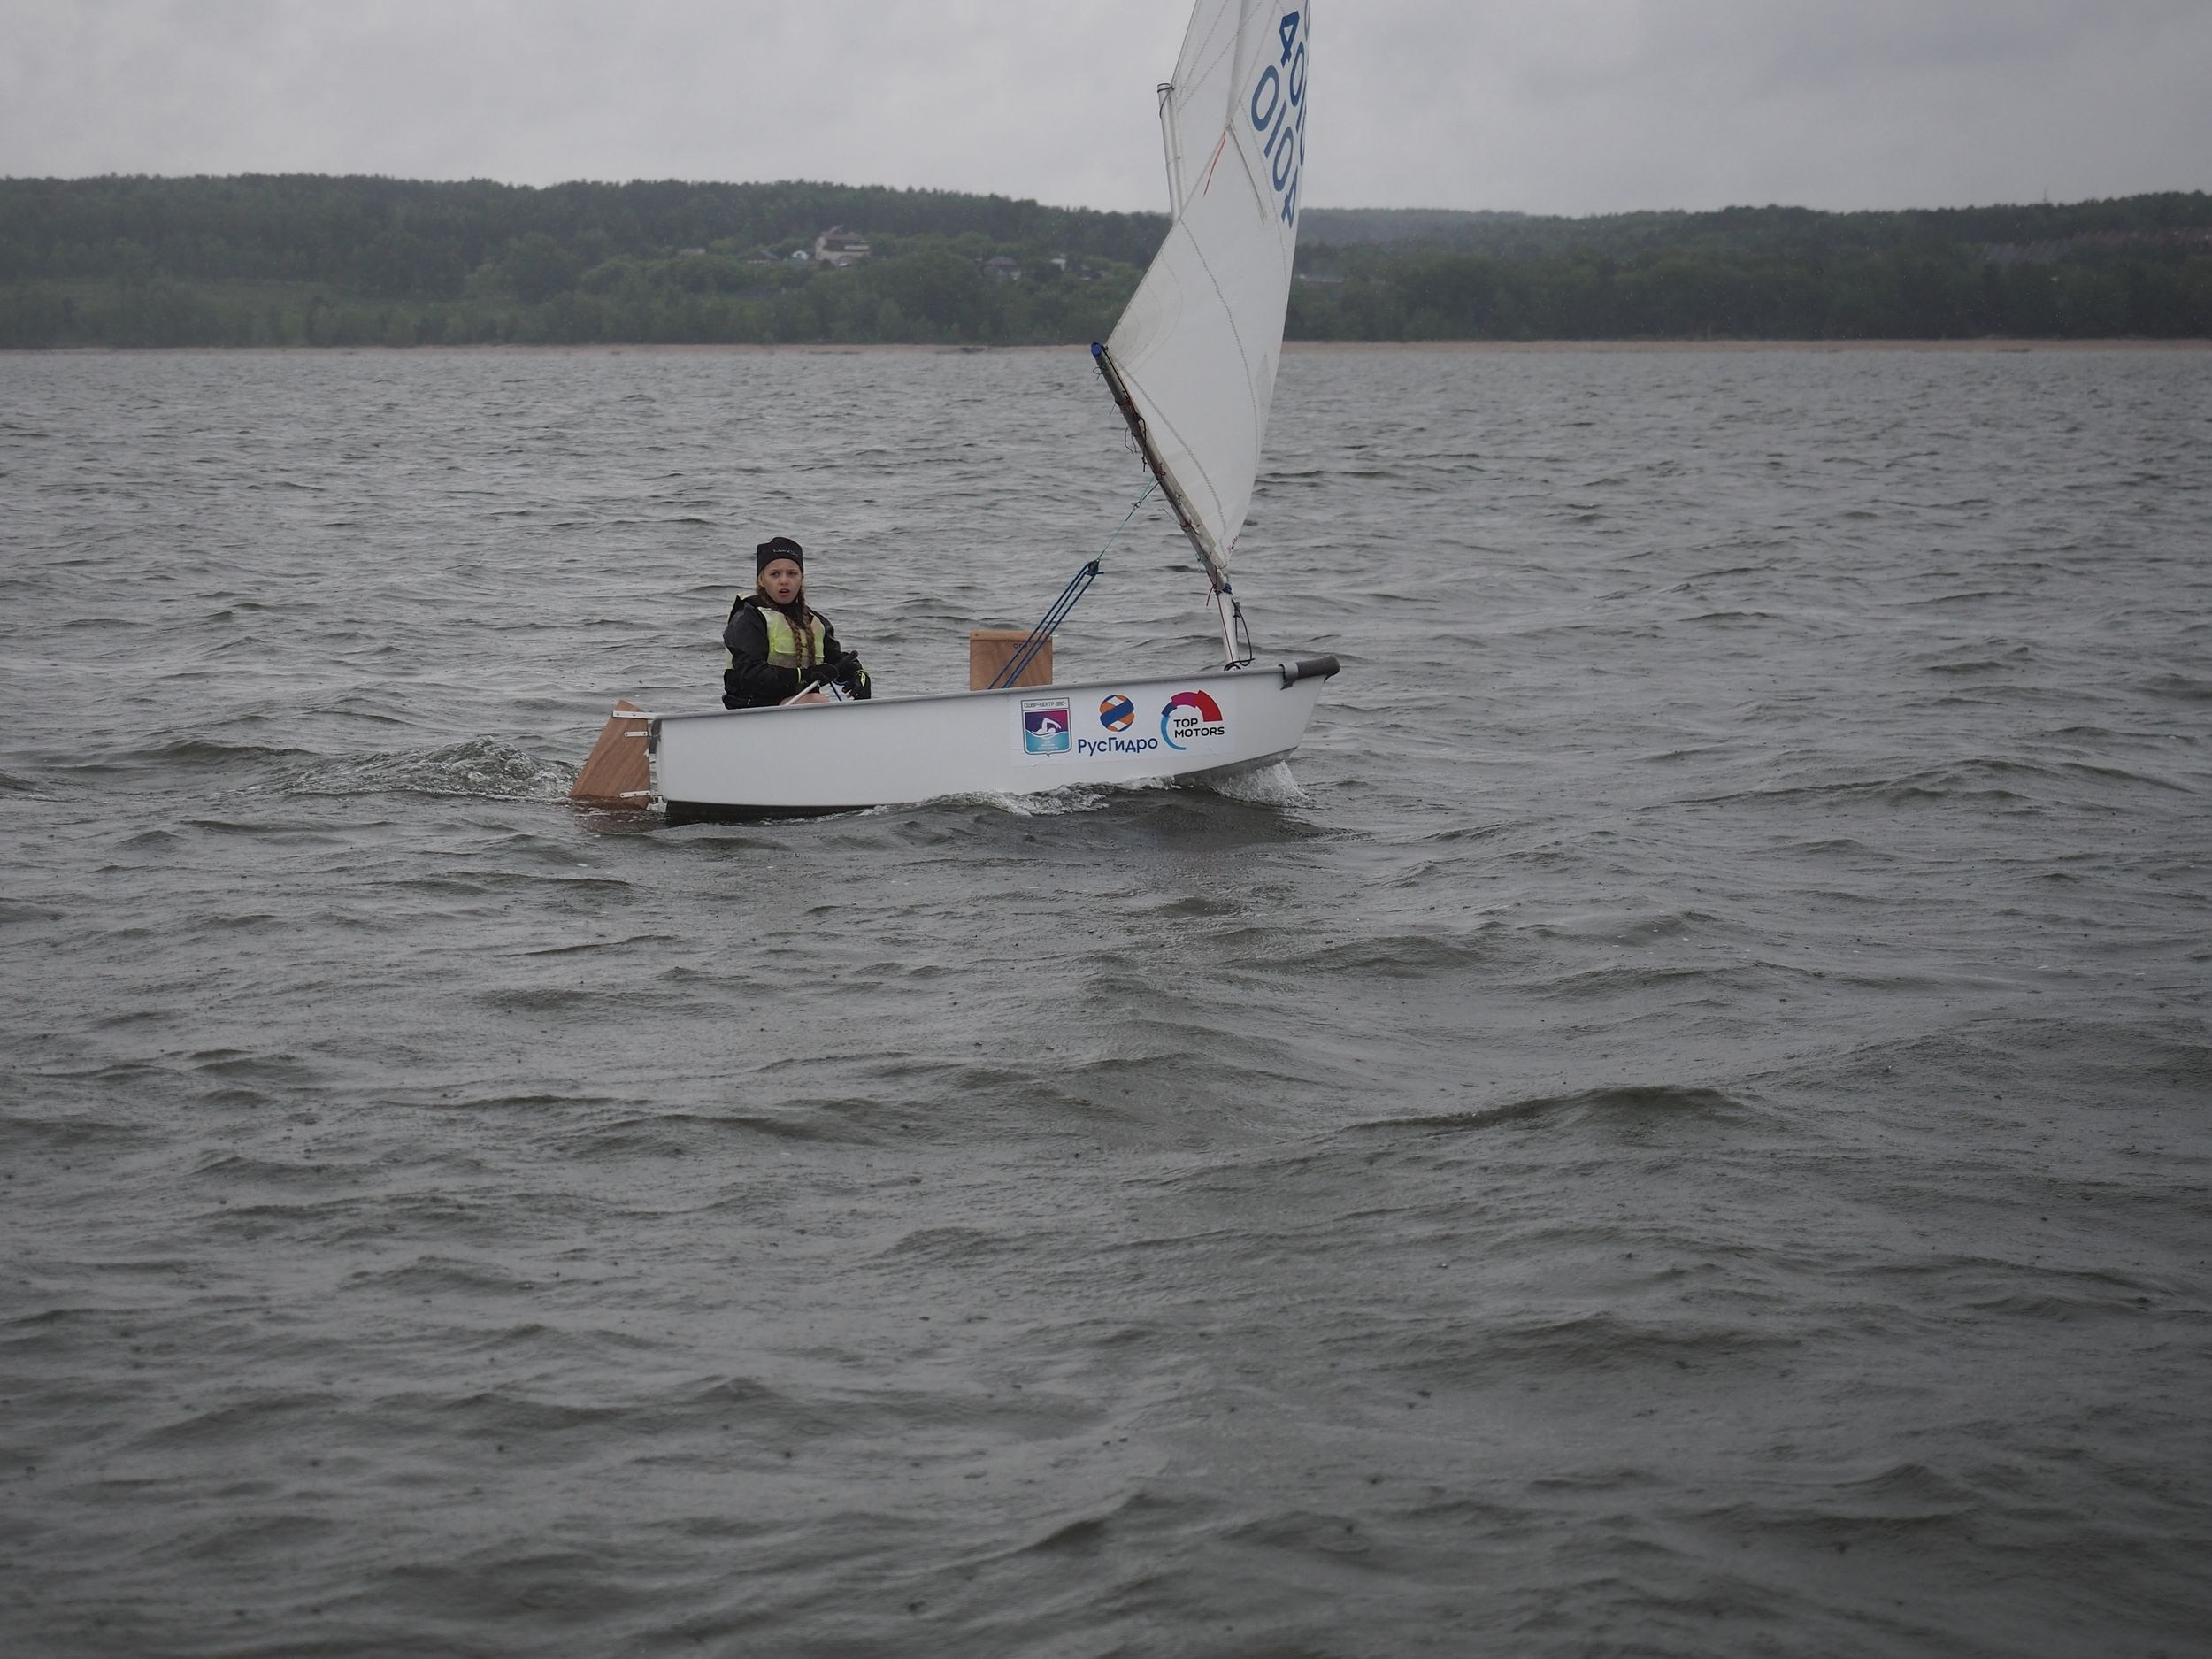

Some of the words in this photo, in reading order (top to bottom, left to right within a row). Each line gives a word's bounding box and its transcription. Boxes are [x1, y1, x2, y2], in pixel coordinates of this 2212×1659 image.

[1173, 718, 1198, 727] TOP
[1174, 726, 1225, 738] MOTORS
[1078, 737, 1158, 757] РусГидро
